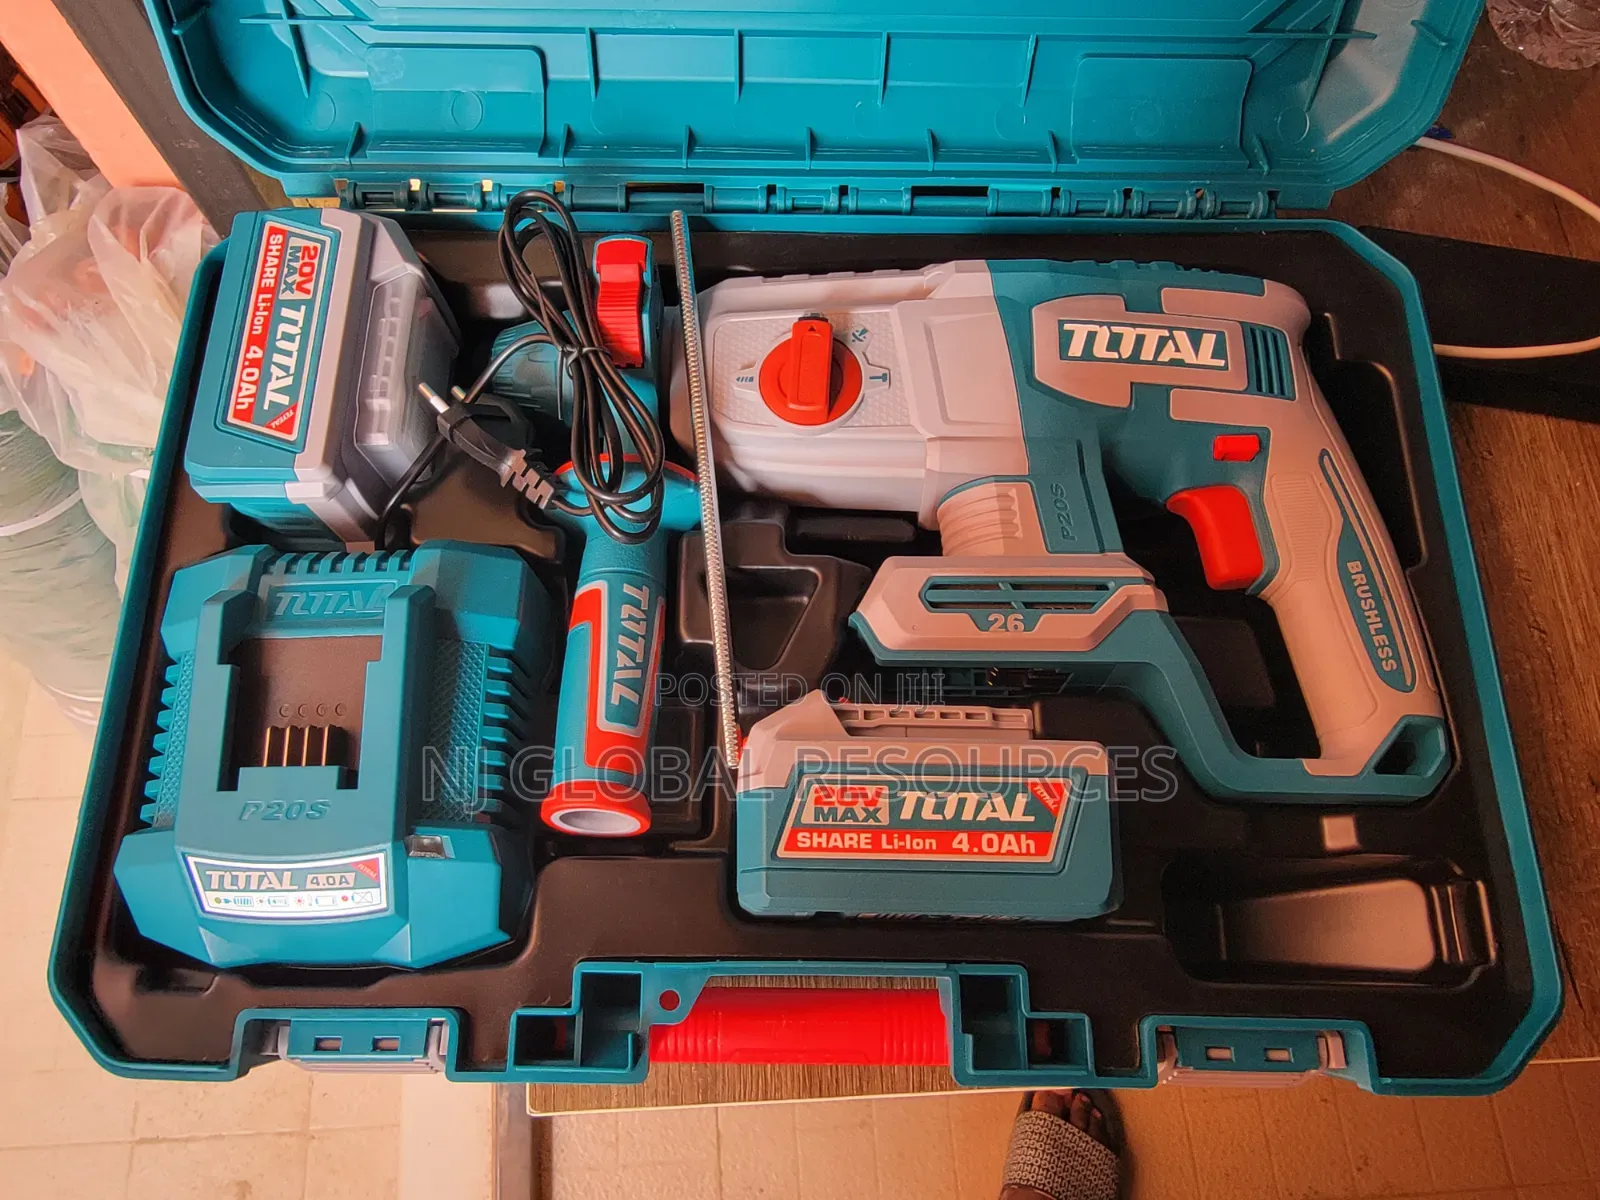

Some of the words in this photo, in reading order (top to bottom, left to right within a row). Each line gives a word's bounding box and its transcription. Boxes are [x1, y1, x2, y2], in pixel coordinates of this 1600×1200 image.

[261, 232, 283, 289] SHARE
[281, 245, 301, 295] MAX
[295, 244, 319, 296] 20V
[251, 293, 271, 335] Li-Ion
[263, 305, 306, 411] TOTAL
[1063, 322, 1226, 366] TOTAL
[235, 345, 263, 411] 4.0Ah
[1050, 483, 1078, 541] P20S
[988, 613, 1025, 632] 26
[1345, 560, 1397, 673] BRUSHLESS
[610, 582, 649, 706] TOTAL
[238, 799, 331, 821] P20S
[813, 785, 886, 807] 20V
[813, 807, 884, 824] MAX
[896, 790, 1036, 823] TOTAL
[796, 832, 872, 850] SHARE
[881, 832, 937, 851] Li-Ion
[951, 832, 1036, 855] 4.0Ah
[205, 870, 299, 891] TOTAL
[310, 873, 351, 888] 4.0A
